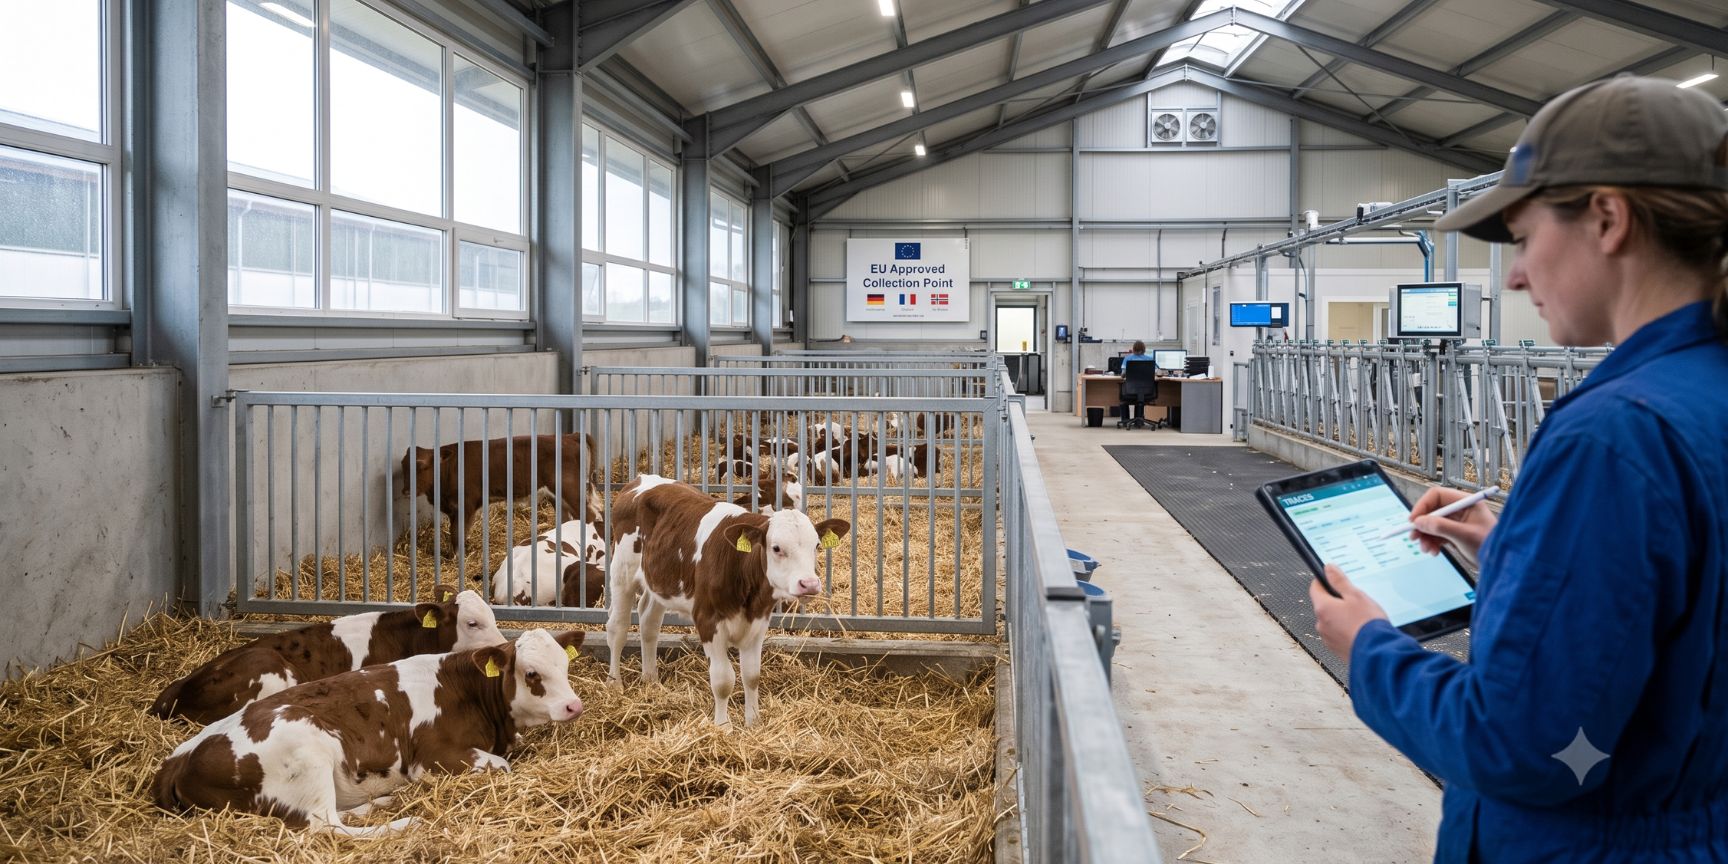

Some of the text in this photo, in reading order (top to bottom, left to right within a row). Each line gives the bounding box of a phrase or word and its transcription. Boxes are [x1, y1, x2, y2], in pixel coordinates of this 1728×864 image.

[871, 264, 945, 275] EU Approved
[863, 278, 953, 288] Collection Point
[1282, 493, 1315, 506] TRACES
